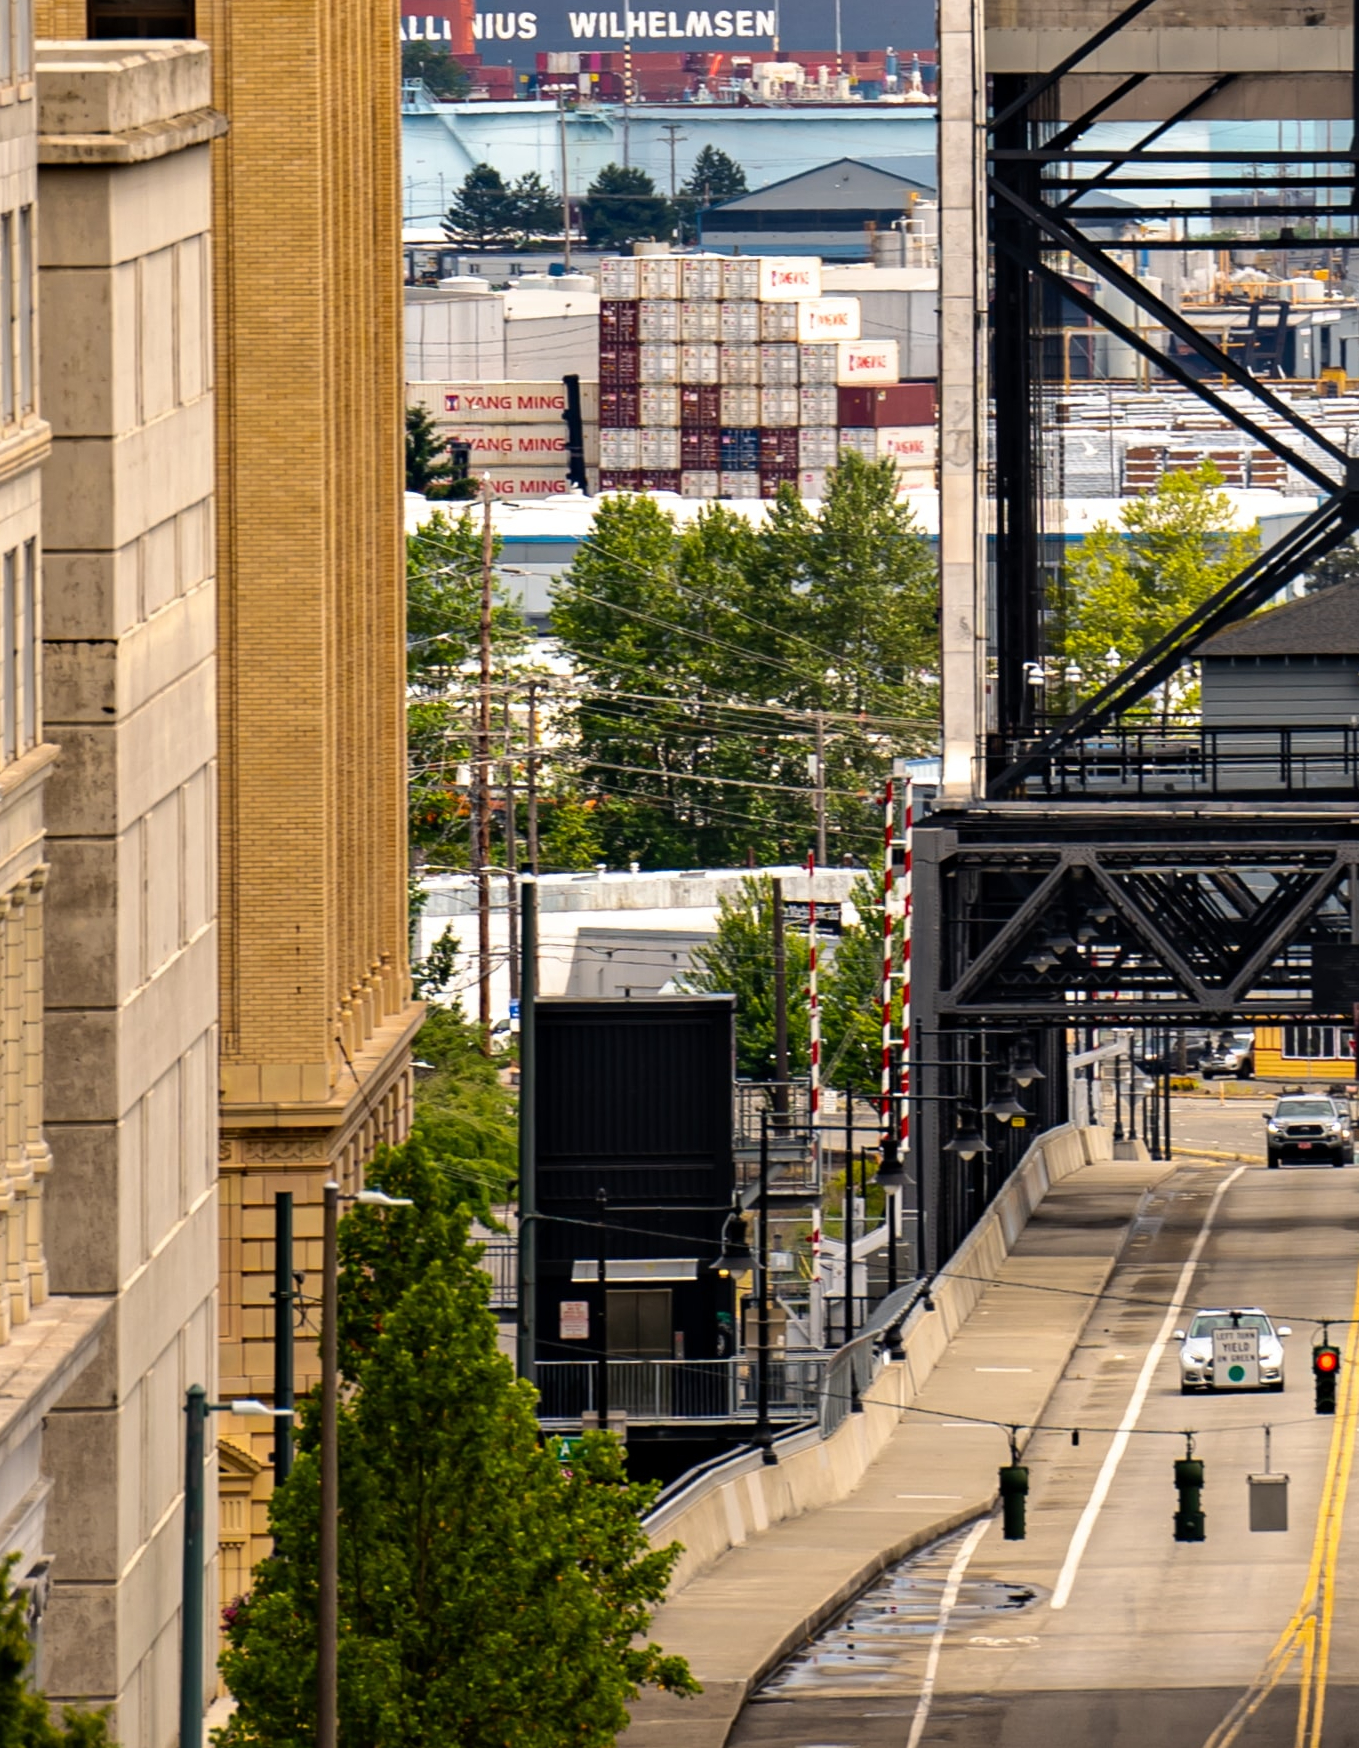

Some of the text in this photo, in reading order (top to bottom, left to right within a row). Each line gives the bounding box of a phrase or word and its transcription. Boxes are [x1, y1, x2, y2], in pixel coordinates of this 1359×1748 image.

[568, 10, 775, 38] WILHELMSEN
[464, 396, 565, 410] YANG MING
[465, 437, 566, 452] YANG MING
[520, 480, 566, 493] MING
[1216, 1332, 1255, 1340] LEFT TURN
[1222, 1342, 1250, 1352] YIELD
[1231, 1354, 1255, 1362] GREEN
